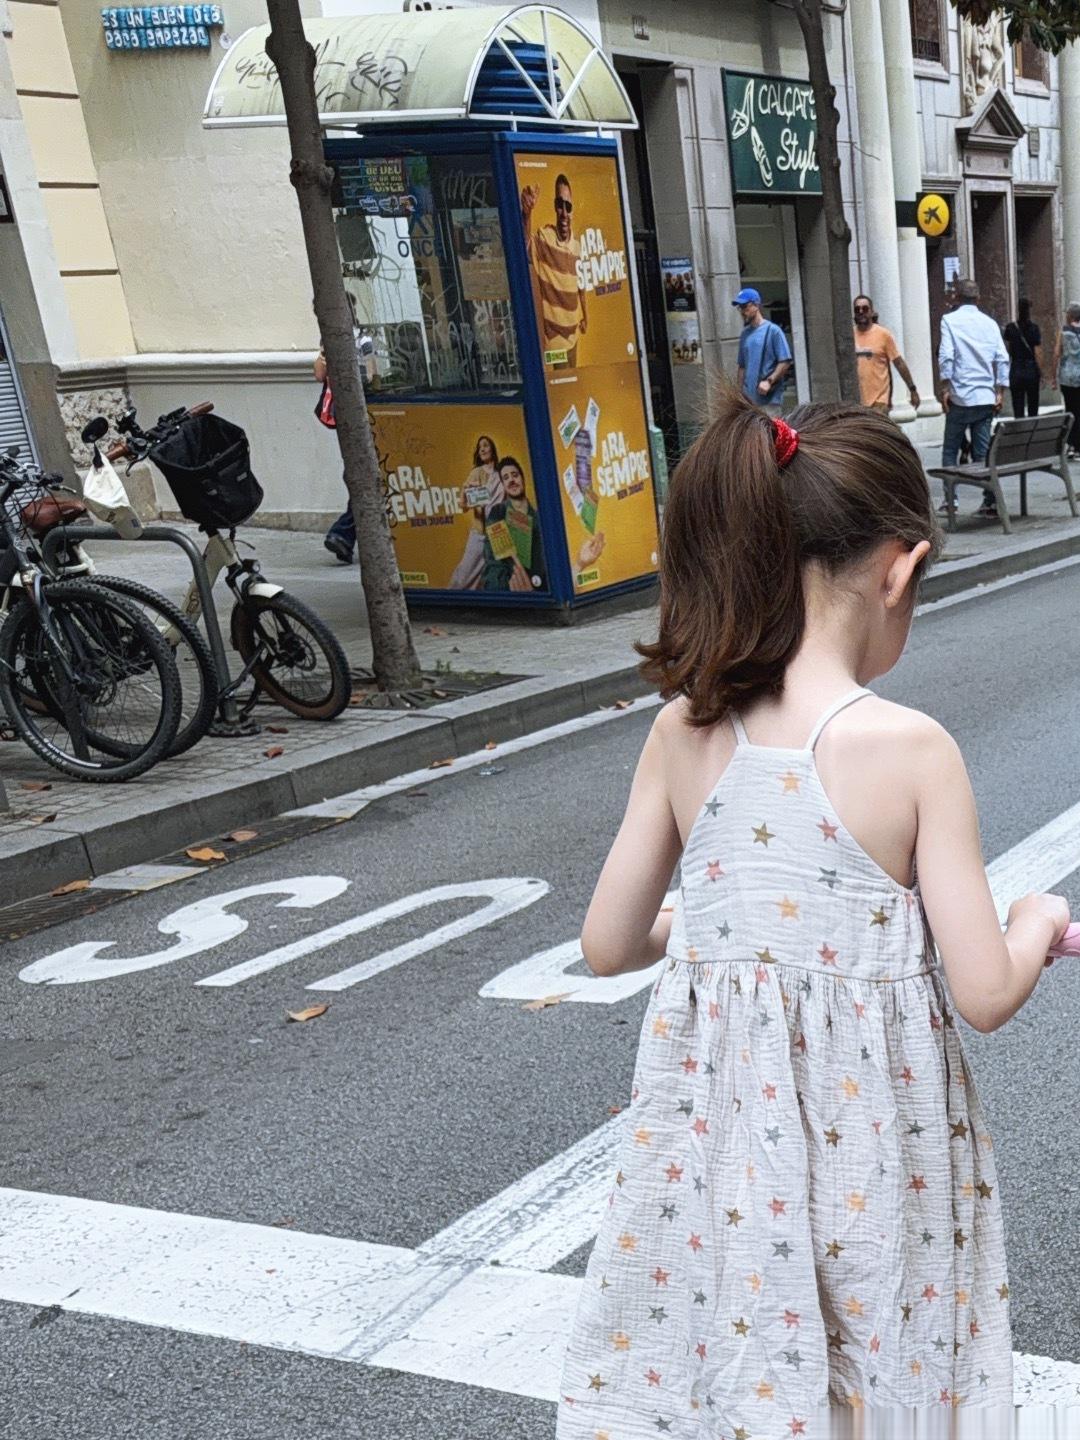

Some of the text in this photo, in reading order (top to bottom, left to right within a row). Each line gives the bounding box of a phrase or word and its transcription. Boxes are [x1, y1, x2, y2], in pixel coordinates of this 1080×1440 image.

[580, 228, 605, 261] ARA
[575, 250, 627, 291] SEMPRE
[602, 432, 626, 467] ARA
[597, 449, 649, 497] SEMPRE
